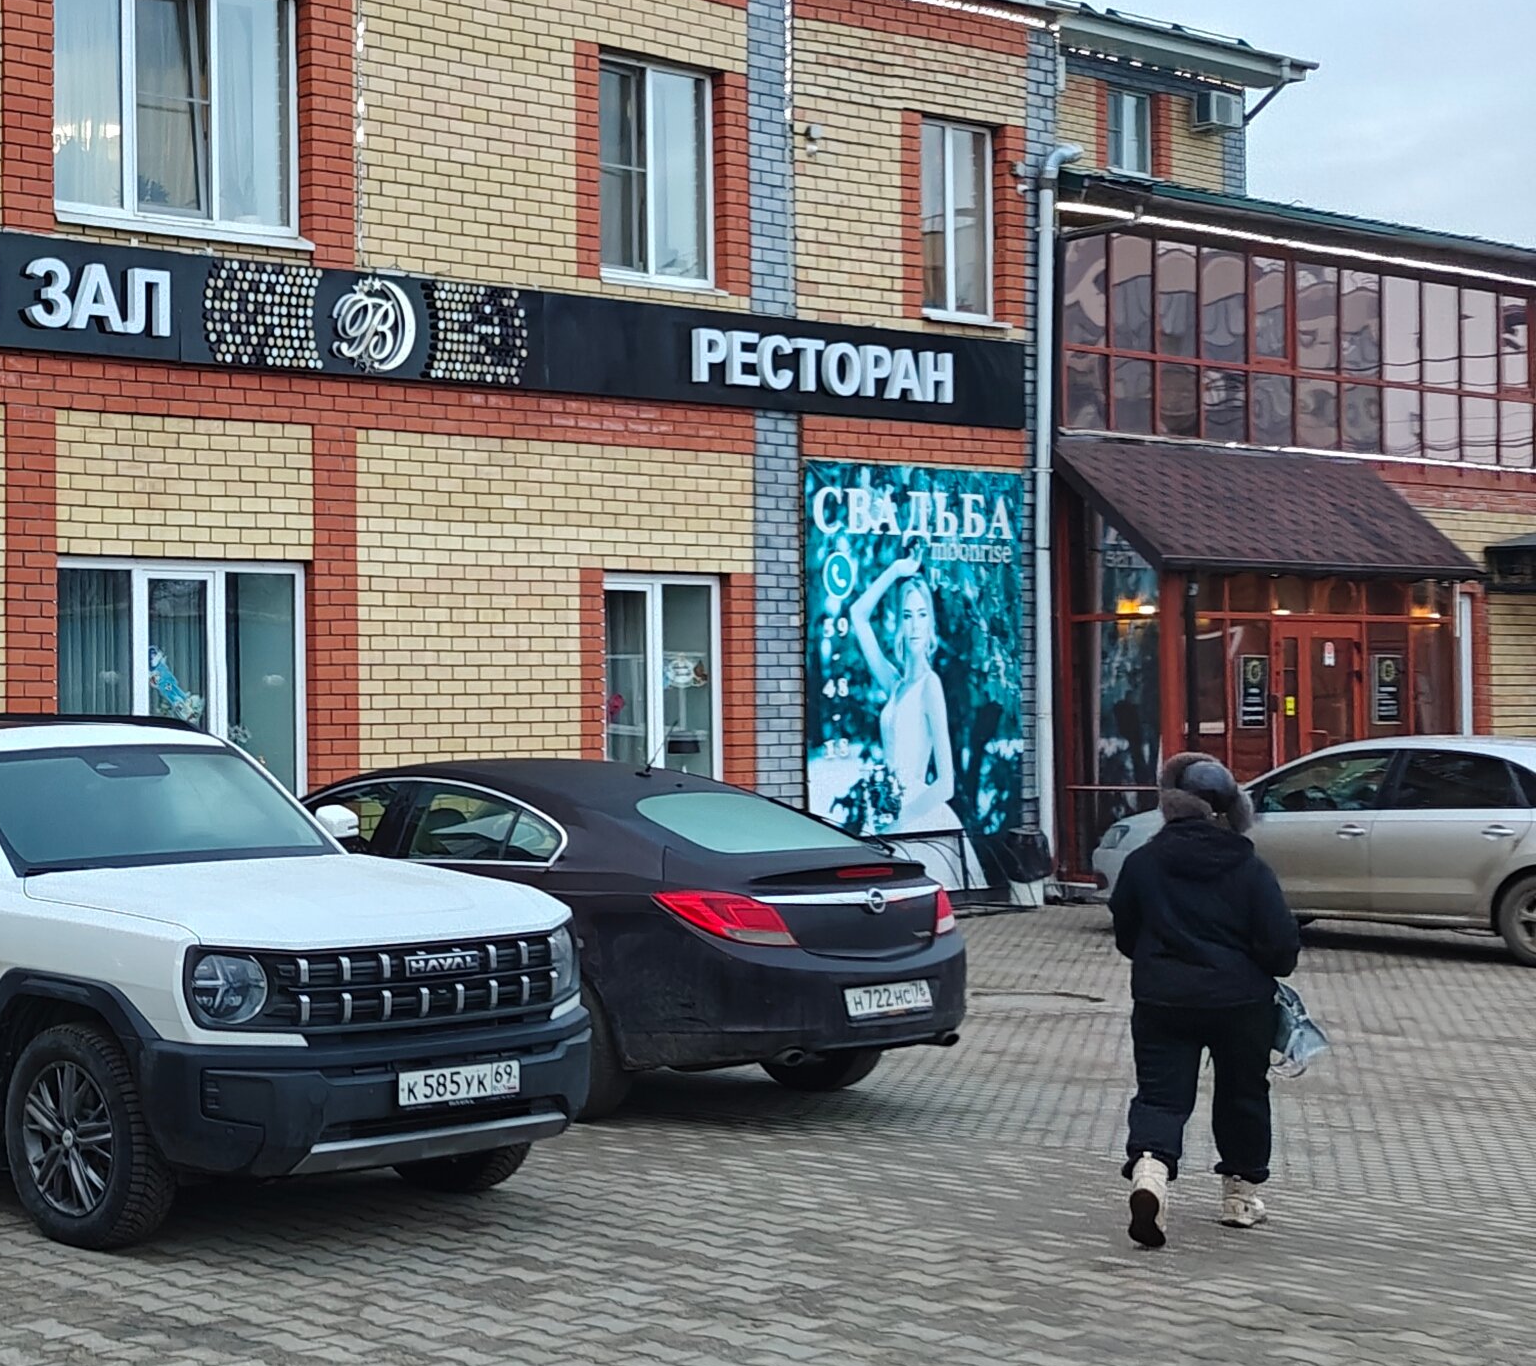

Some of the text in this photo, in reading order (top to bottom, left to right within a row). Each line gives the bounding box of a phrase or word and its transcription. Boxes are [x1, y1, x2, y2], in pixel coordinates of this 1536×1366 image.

[22, 257, 172, 337] ЗАЛ
[691, 327, 954, 404] РЕСТОРАН
[813, 486, 1013, 548] СВАДЬБА
[410, 955, 479, 973] HAVAL
[493, 1064, 514, 1084] 69
